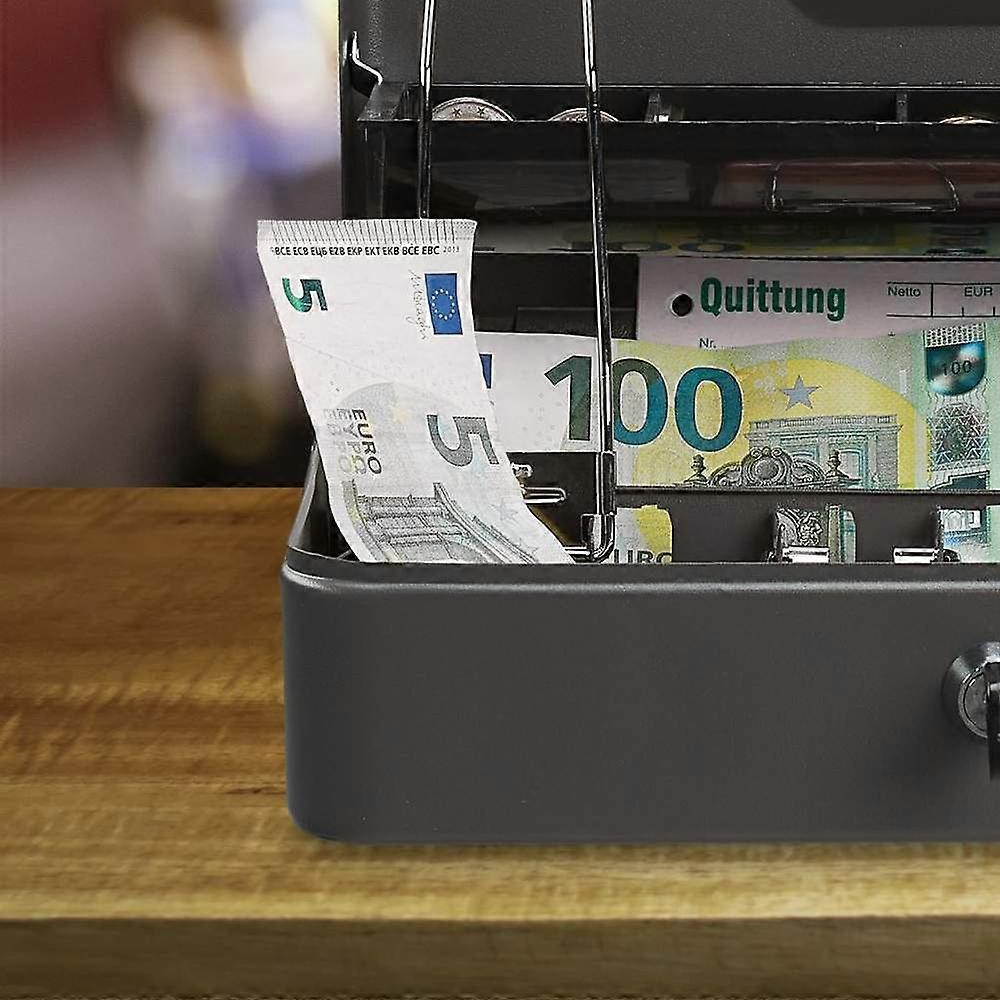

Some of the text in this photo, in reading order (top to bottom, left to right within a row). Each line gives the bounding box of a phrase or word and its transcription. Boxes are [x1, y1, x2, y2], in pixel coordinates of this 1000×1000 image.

[275, 246, 291, 256] BCE
[293, 246, 308, 256] ECB
[347, 246, 363, 256] EKP
[365, 246, 380, 256] EKT
[382, 246, 399, 256] EKB
[422, 245, 440, 255] EBC
[282, 277, 328, 312] 5
[700, 277, 846, 321] Quittung
[888, 286, 993, 297] Netto EUR
[699, 337, 716, 348] Nr.
[942, 360, 973, 377] 100
[544, 355, 742, 452] 100
[352, 409, 382, 475] EURO
[426, 413, 499, 467] 5
